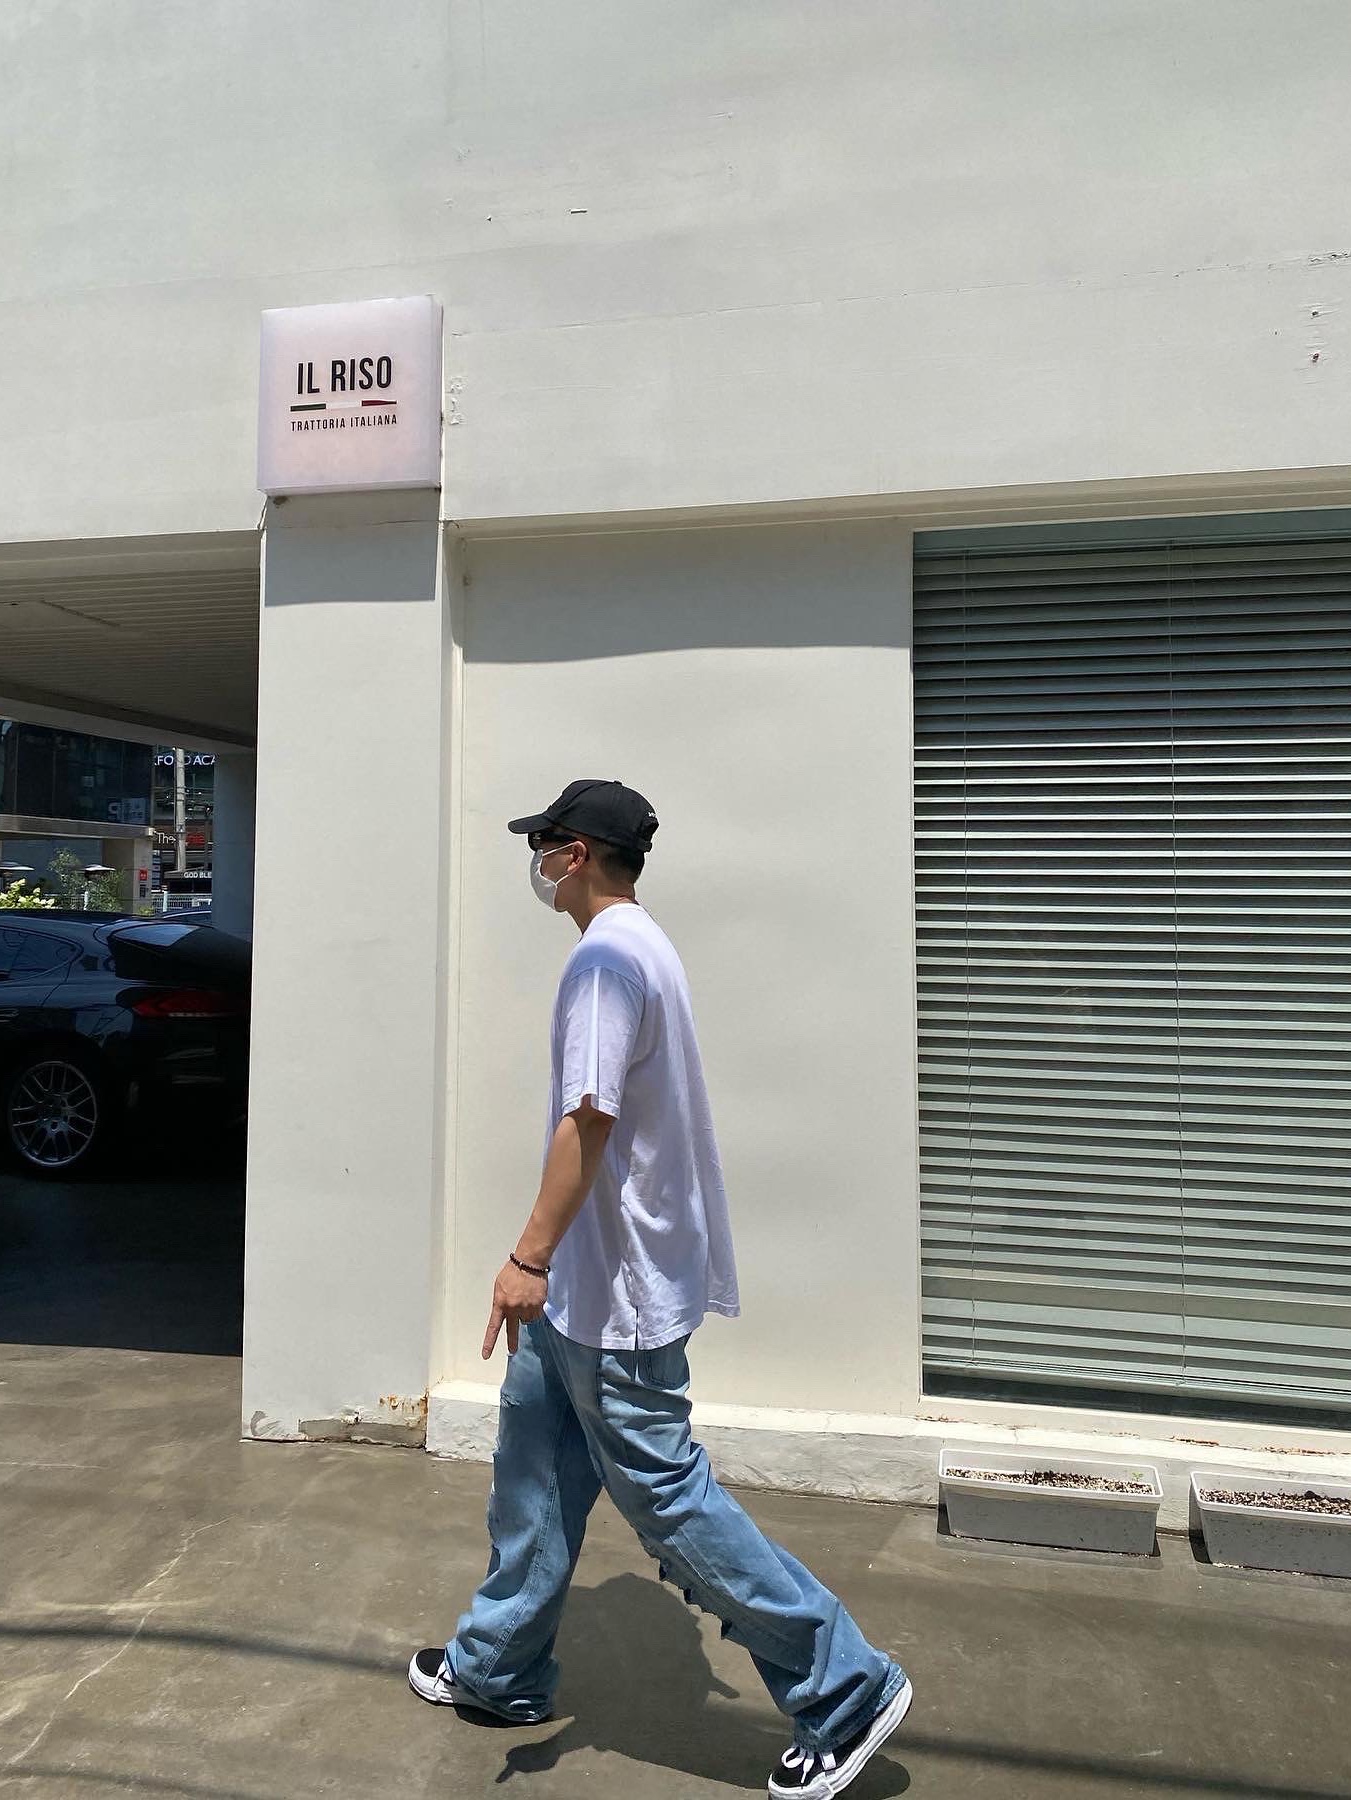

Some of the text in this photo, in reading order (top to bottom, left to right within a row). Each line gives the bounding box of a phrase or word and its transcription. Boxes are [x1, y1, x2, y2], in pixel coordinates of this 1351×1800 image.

[298, 356, 392, 394] IL RISO
[290, 414, 397, 432] TRATTORIA ITALIANA
